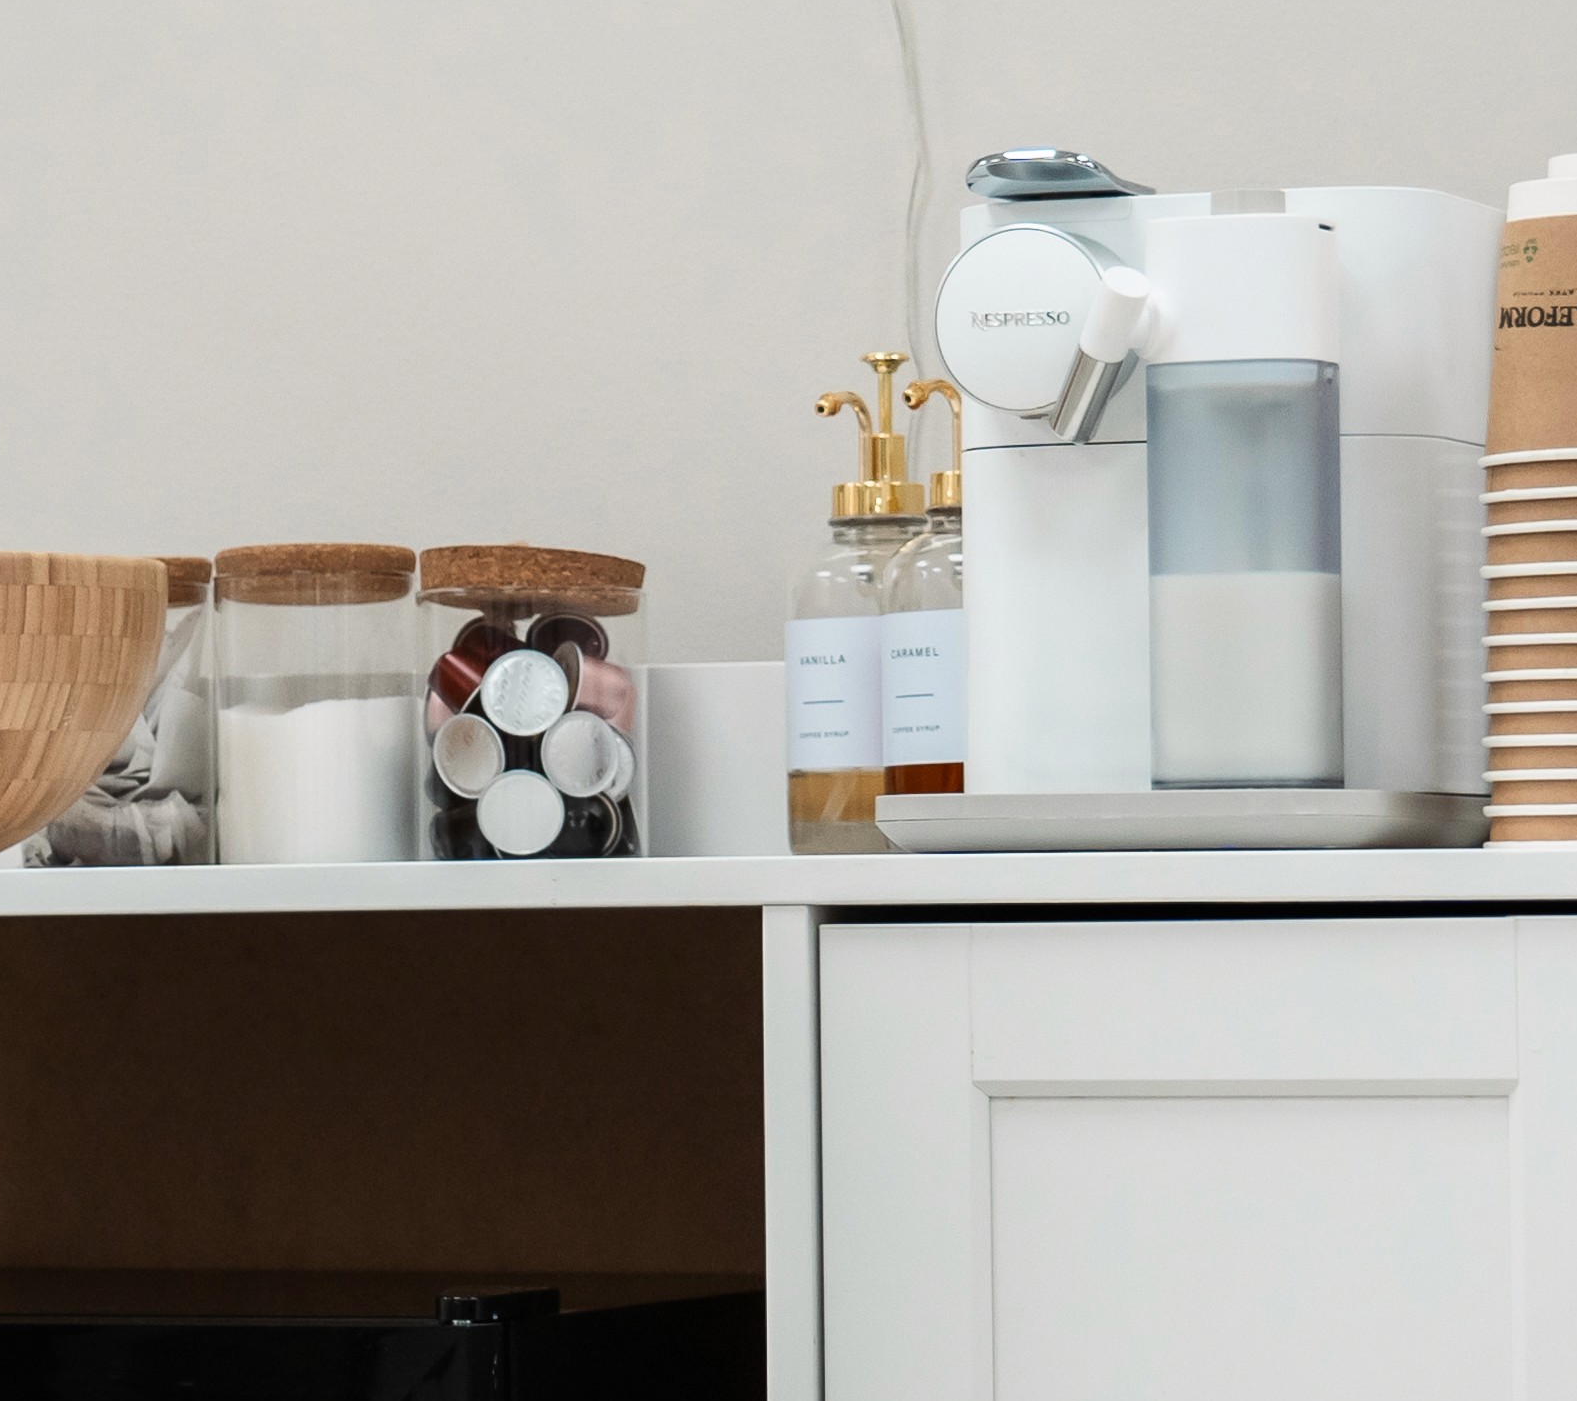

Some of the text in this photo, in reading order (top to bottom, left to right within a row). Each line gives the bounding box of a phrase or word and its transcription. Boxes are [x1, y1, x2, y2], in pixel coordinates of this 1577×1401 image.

[968, 310, 1070, 331] NESPRESSO
[799, 654, 846, 666] VANILLA
[891, 647, 940, 660] CARAMEL
